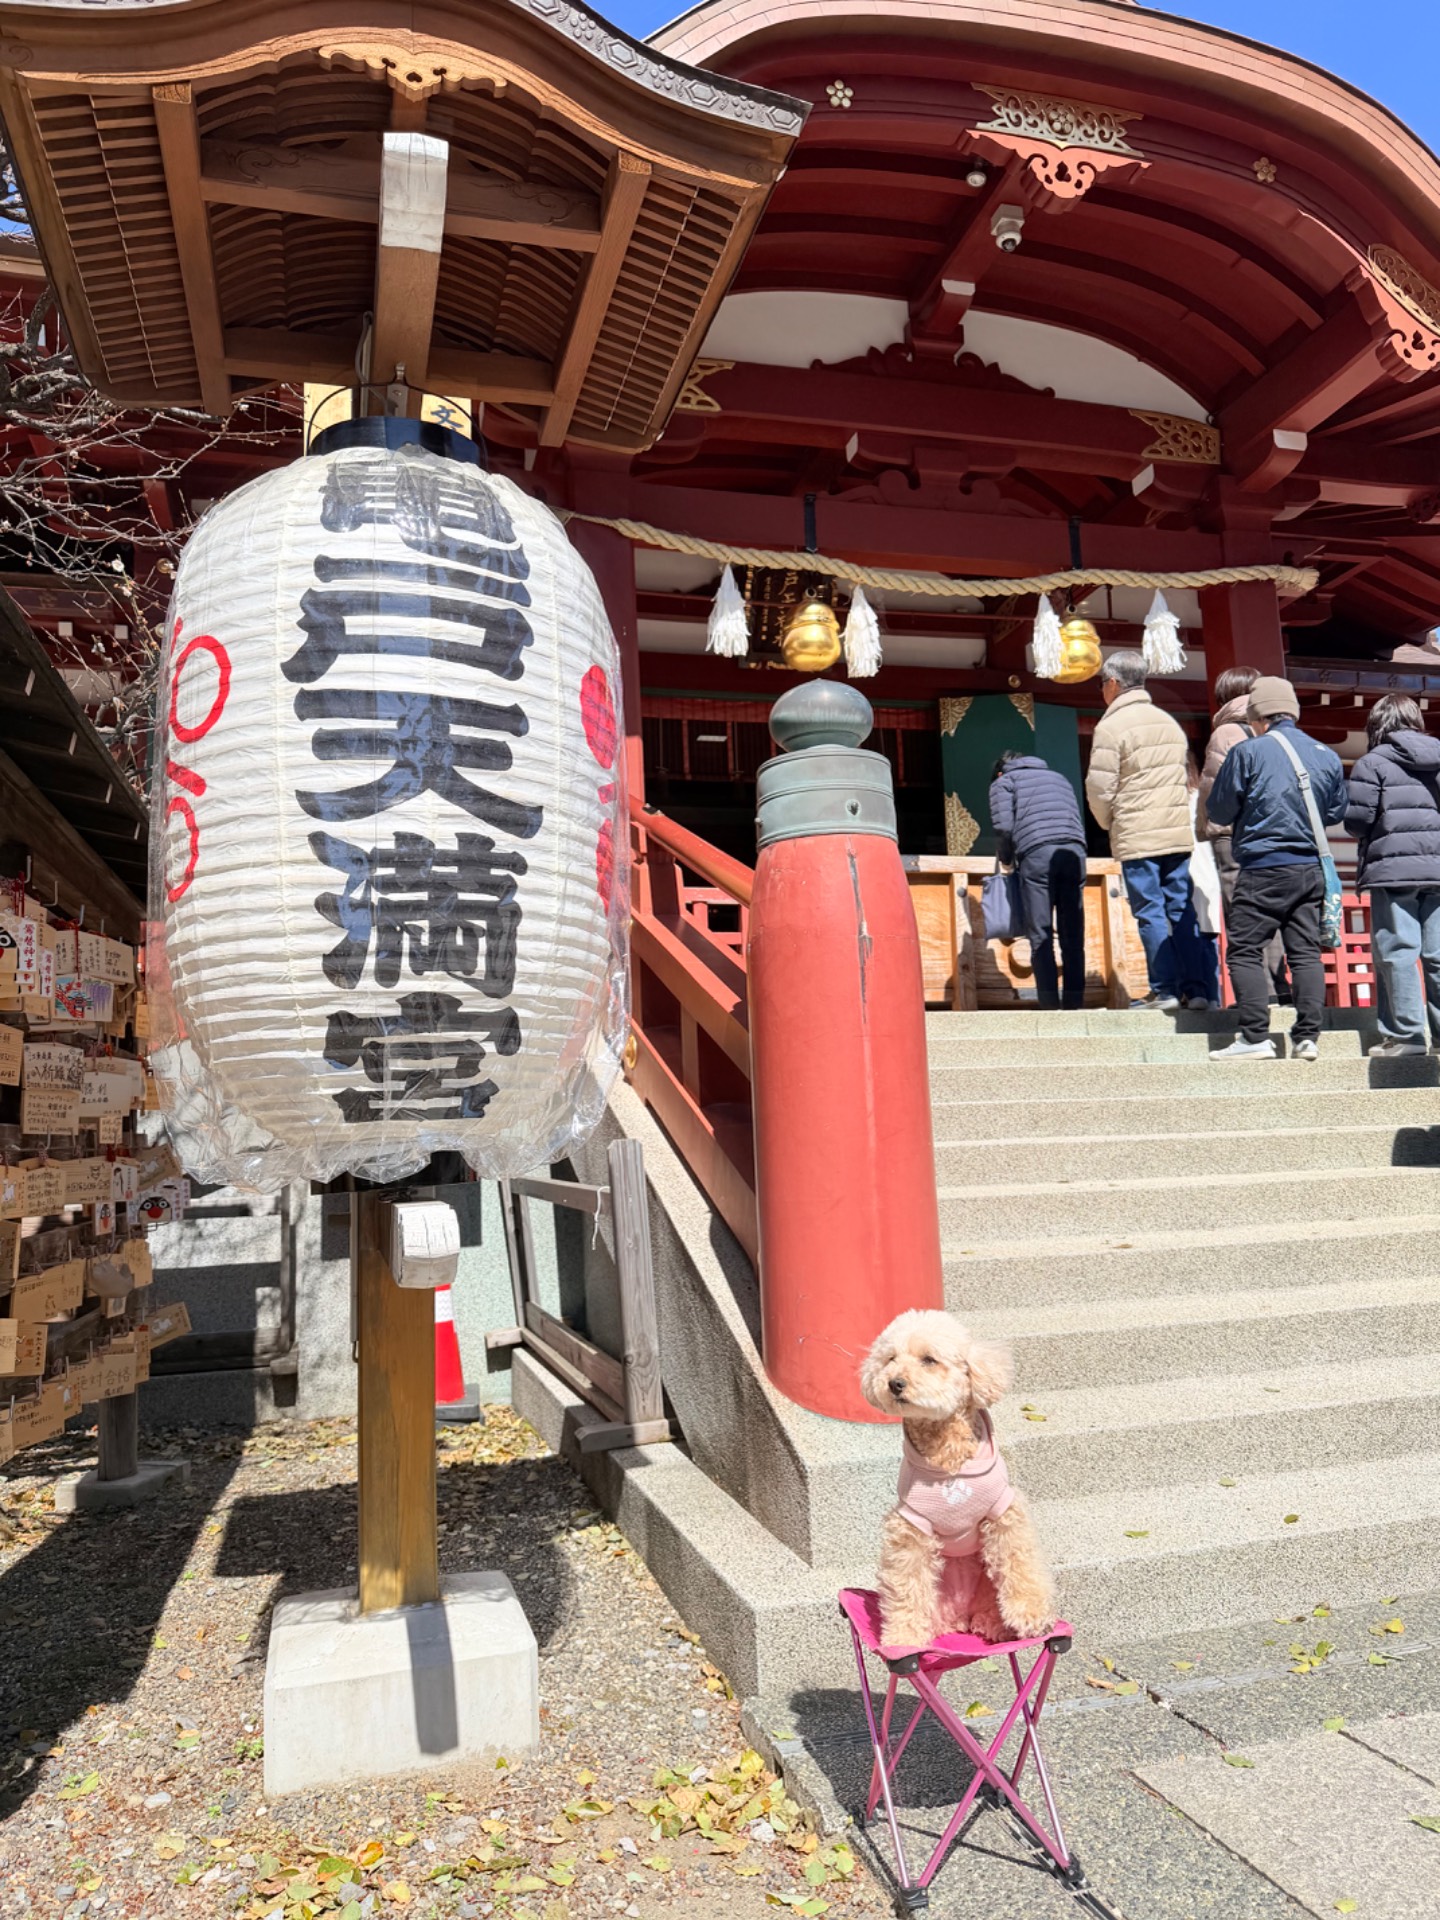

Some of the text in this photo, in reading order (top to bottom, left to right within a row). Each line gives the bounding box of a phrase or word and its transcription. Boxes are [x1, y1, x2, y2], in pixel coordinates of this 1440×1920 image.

[280, 460, 543, 1124] 亀戸天満宮
